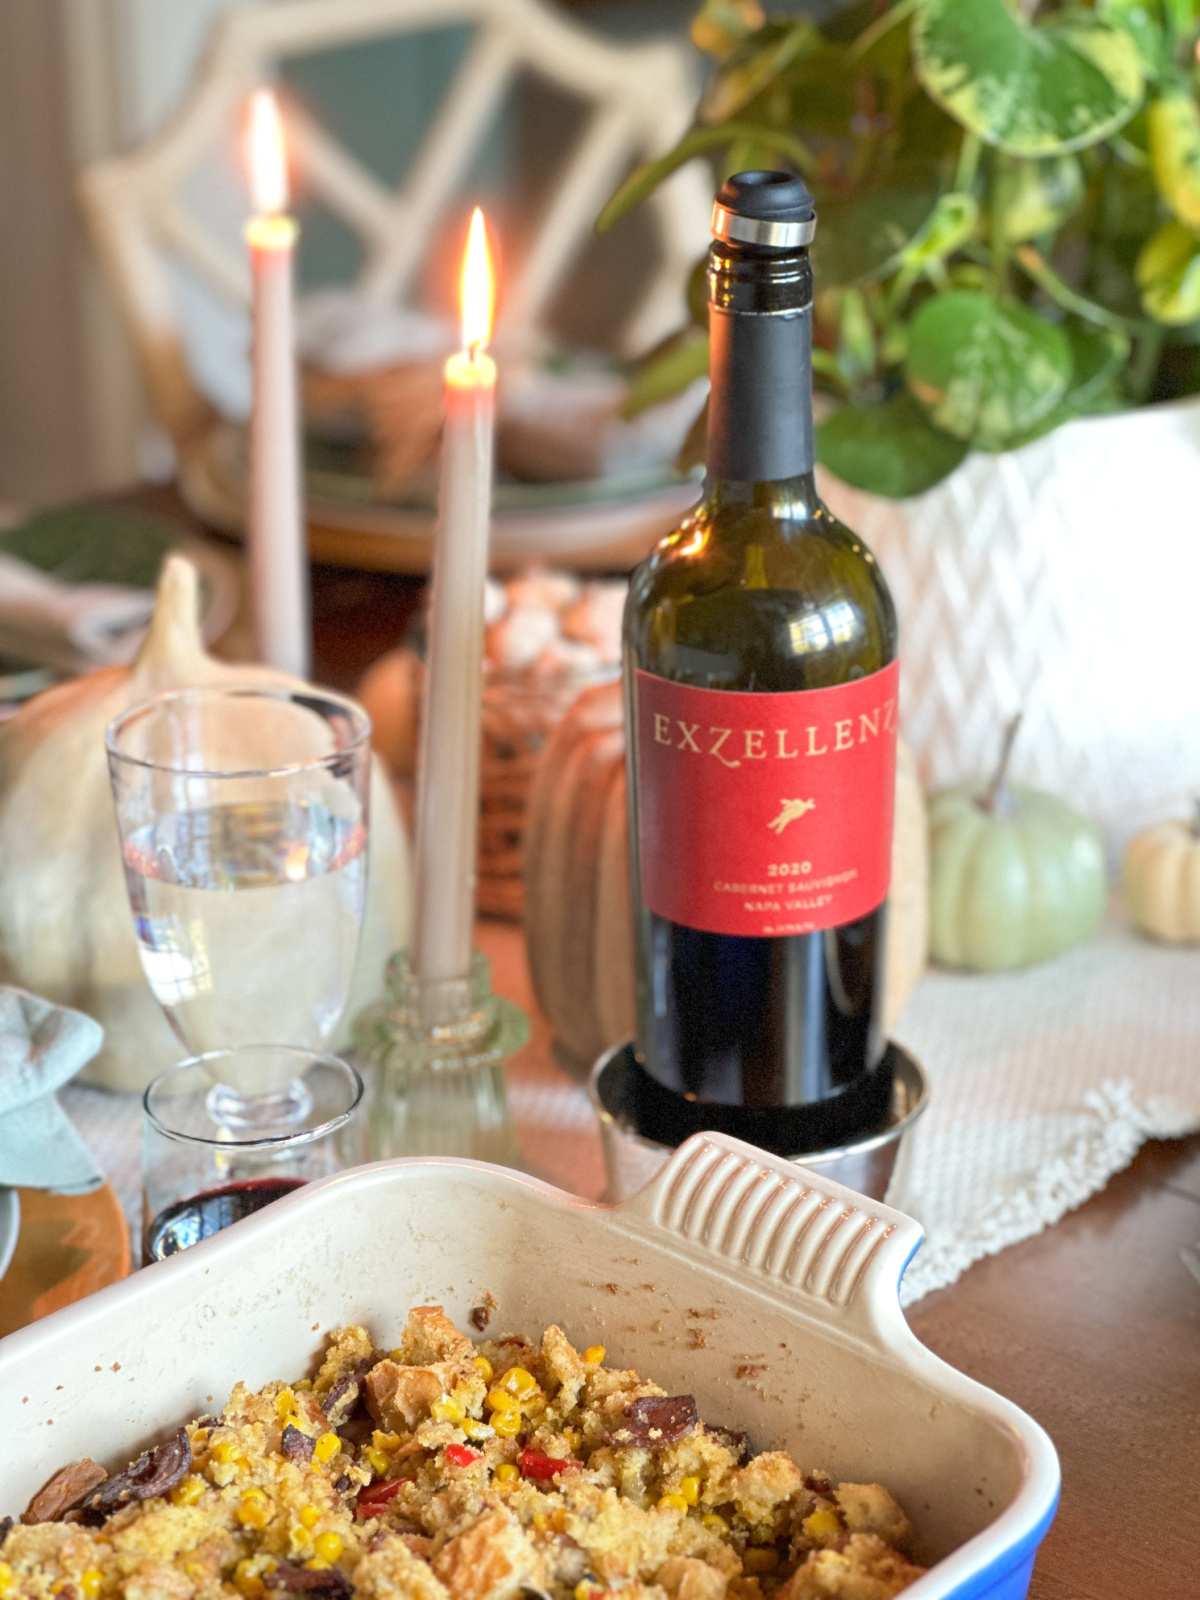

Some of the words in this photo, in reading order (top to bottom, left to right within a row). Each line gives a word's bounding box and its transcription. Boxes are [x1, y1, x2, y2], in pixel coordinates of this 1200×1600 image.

[653, 698, 897, 768] EXZELLENZ
[767, 861, 812, 877] 2020
[713, 881, 784, 895] CABERNET
[744, 901, 781, 912] NAPA
[784, 894, 833, 911] VALLEY
